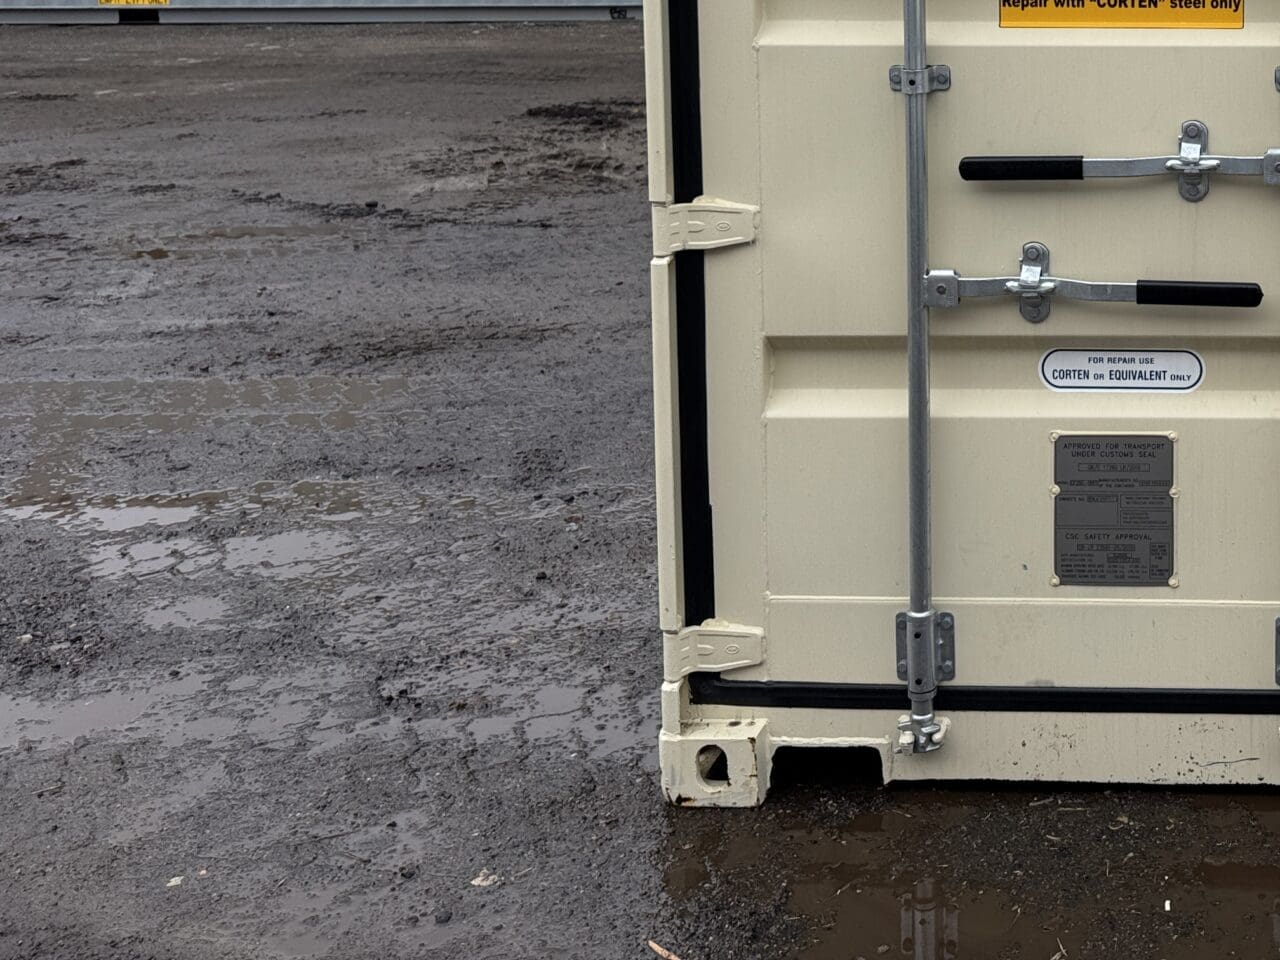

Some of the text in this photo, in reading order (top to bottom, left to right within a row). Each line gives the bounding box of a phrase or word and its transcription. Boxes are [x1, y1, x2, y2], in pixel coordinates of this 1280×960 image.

[1088, 356, 1155, 365] FOR REPAIR USE
[1052, 369, 1192, 382] CORTEN OR EQUIVALENT ONLY
[1115, 533, 1152, 541] APPROVAL
